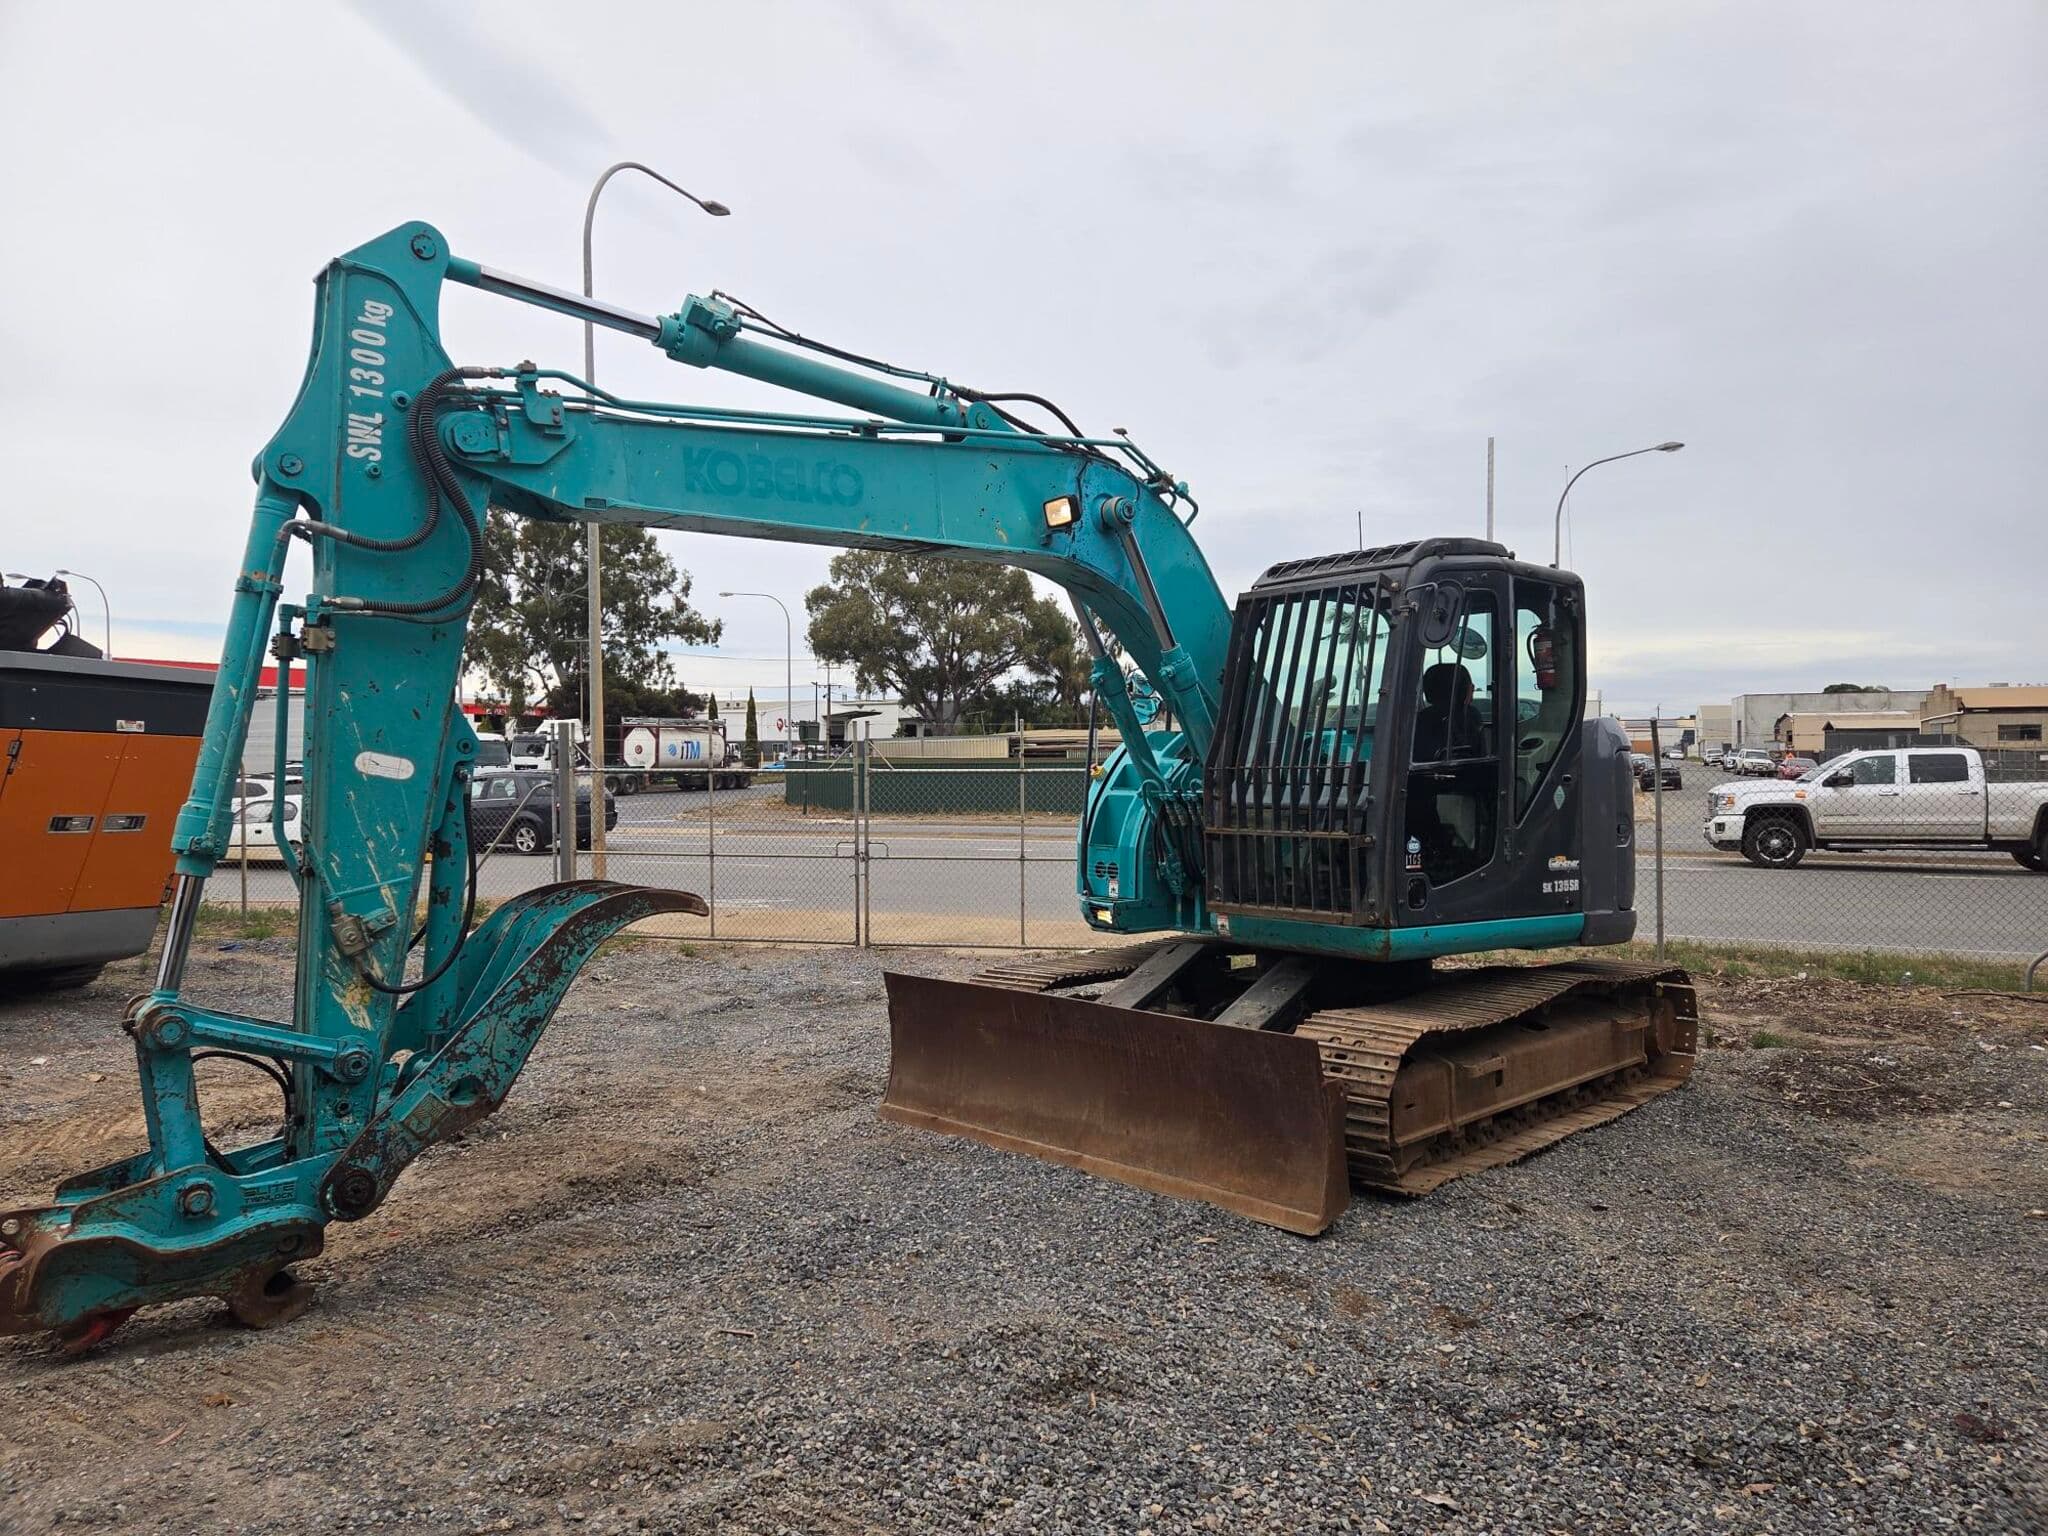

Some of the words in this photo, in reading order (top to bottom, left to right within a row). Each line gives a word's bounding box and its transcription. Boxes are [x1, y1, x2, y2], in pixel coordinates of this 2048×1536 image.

[347, 412, 383, 462] SWL
[683, 445, 864, 507] KOBELCO
[1554, 879, 1580, 893] 135SR
